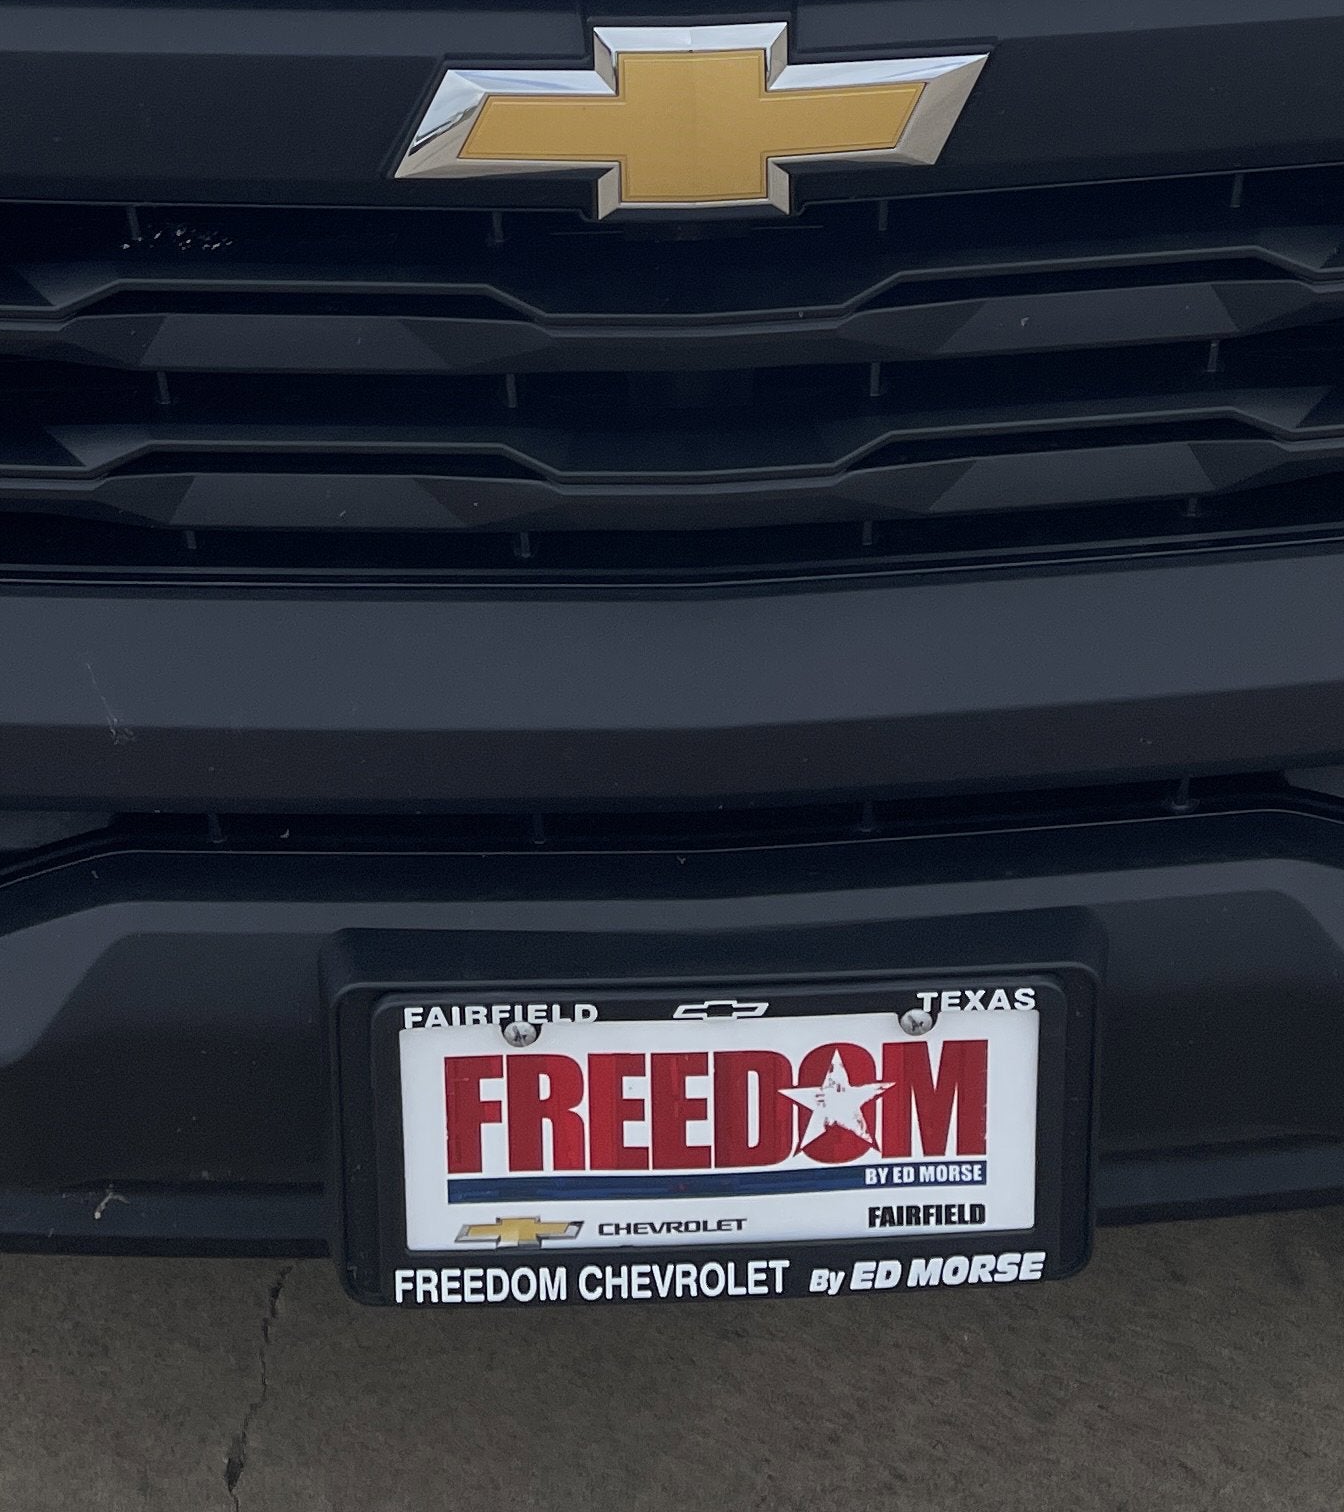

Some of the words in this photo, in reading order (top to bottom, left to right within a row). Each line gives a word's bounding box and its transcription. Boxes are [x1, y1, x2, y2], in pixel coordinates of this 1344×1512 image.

[403, 1003, 599, 1029] FAIRFIELD
[916, 988, 1036, 1013] TEXAS
[444, 1039, 989, 1174] FREEDOM
[865, 1167, 888, 1185] BY
[892, 1165, 915, 1184] ED
[919, 1163, 982, 1183] MORSE
[598, 1218, 748, 1236] CHEVROLET
[868, 1203, 986, 1229] FAIRFIELD
[394, 1266, 567, 1303] FREEDOM
[578, 1259, 790, 1301] CHEVROLET
[809, 1267, 845, 1295] By
[850, 1260, 902, 1290] ED
[907, 1251, 1046, 1287] MORSE
